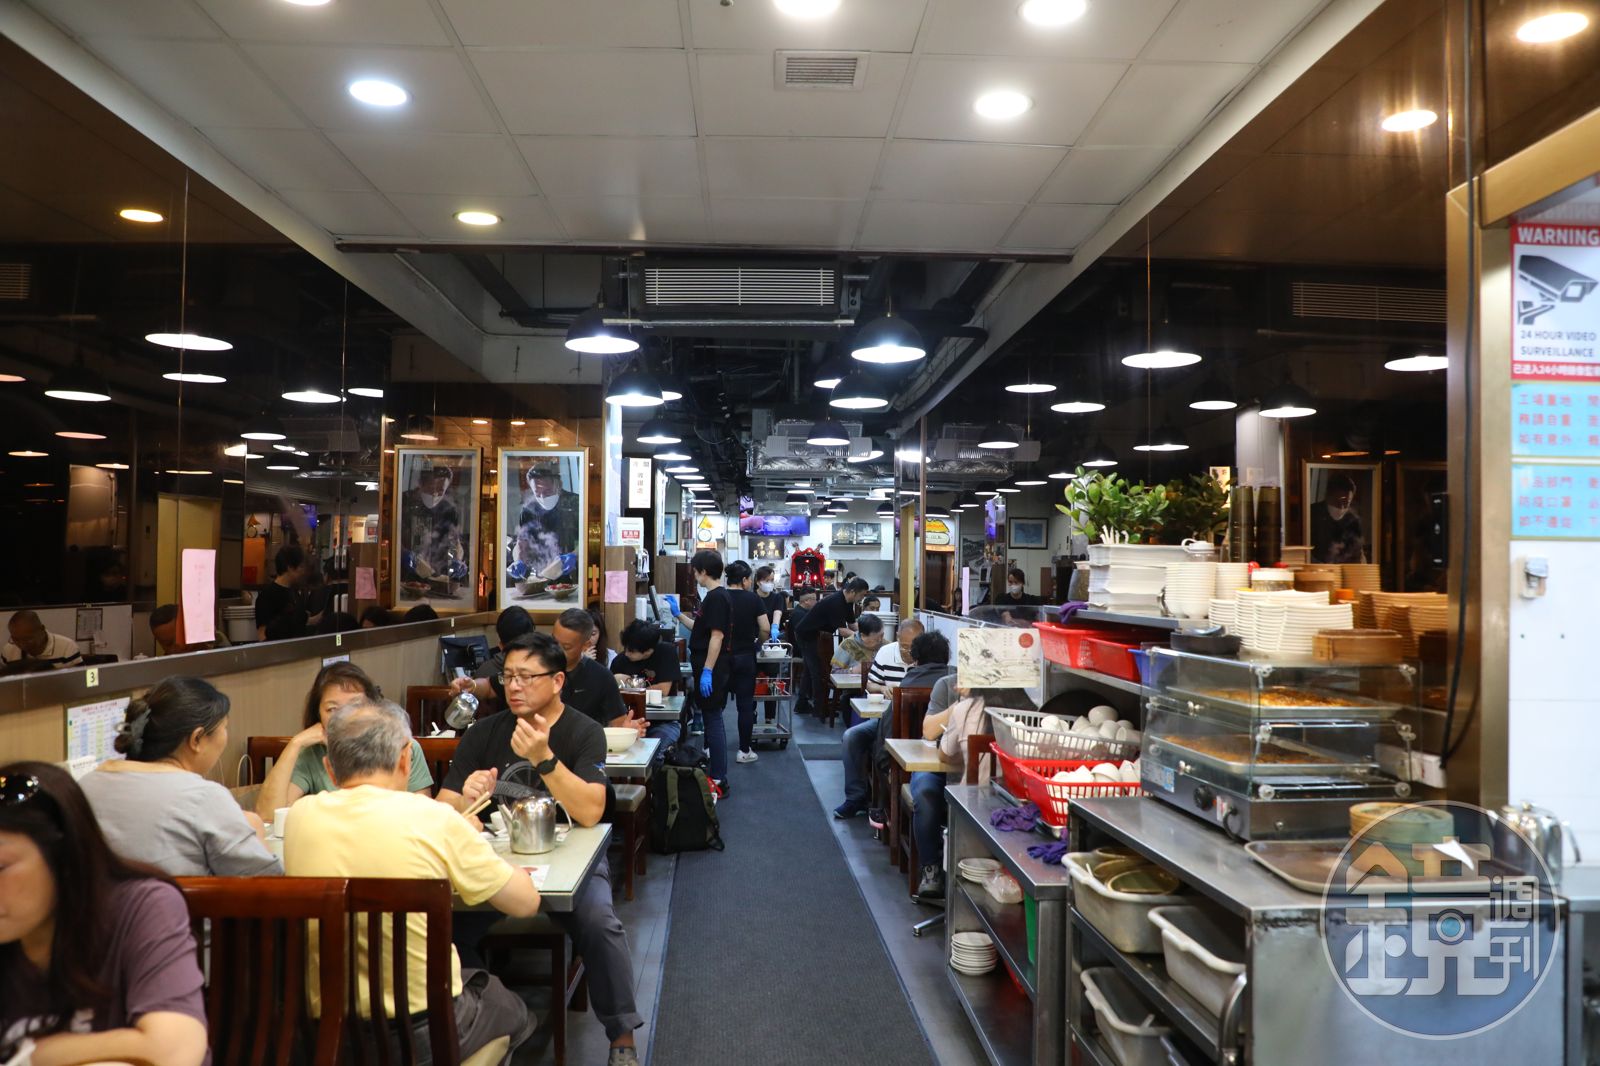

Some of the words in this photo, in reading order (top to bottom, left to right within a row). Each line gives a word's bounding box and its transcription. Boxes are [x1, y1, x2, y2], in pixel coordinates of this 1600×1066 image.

[1517, 226, 1600, 246] WARNING
[1520, 330, 1533, 340] 24
[1535, 331, 1563, 341] HOUR
[1565, 332, 1597, 342] VIDEO
[1520, 346, 1594, 358] SURVEILLANCE
[90, 671, 96, 683] 3
